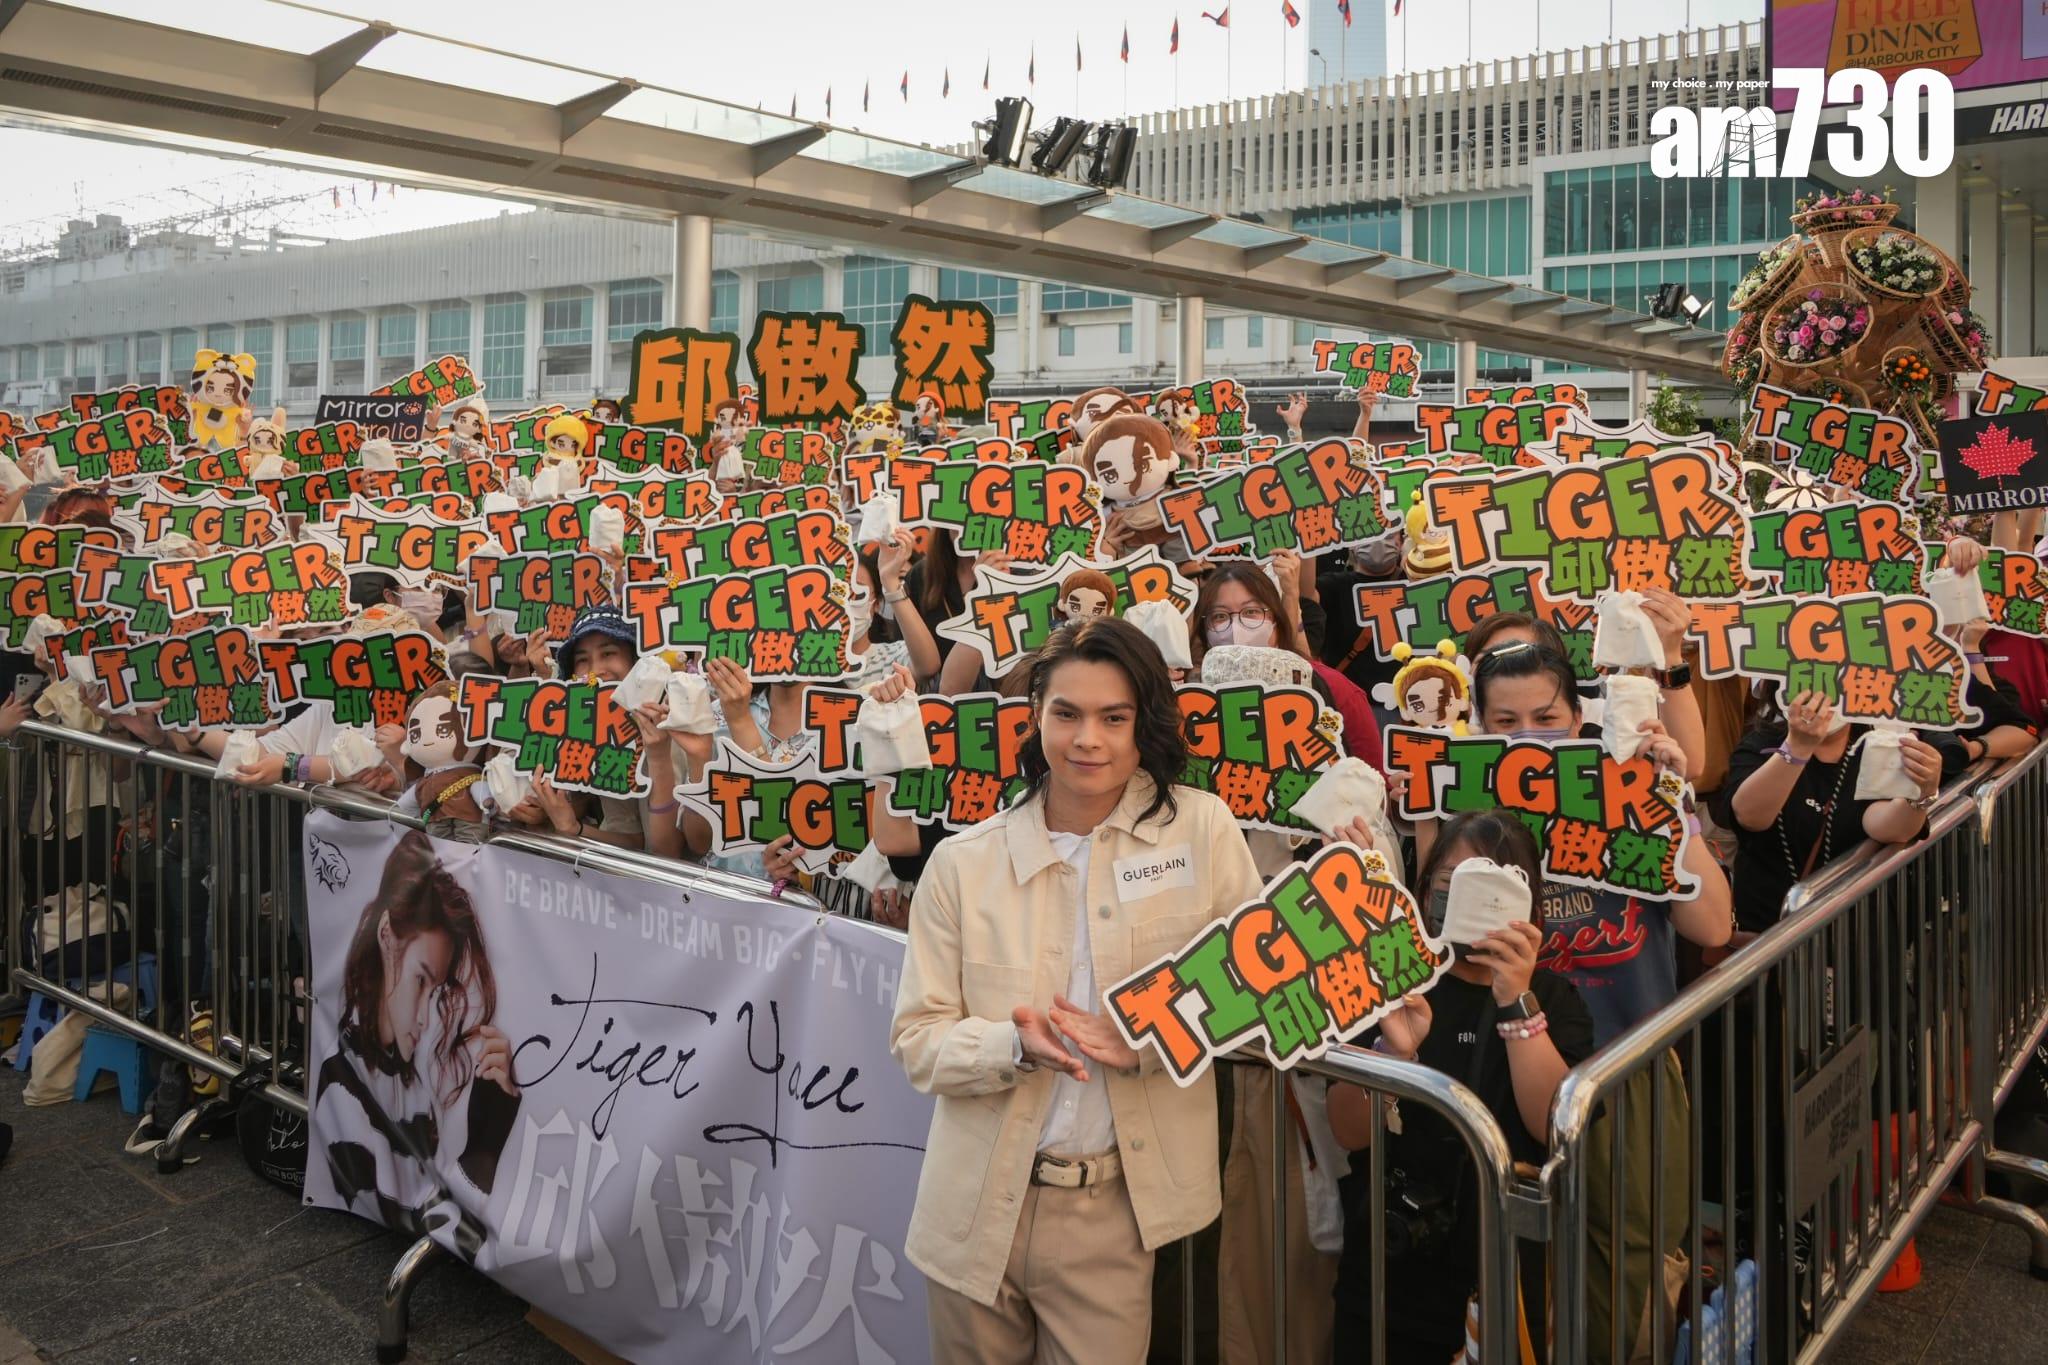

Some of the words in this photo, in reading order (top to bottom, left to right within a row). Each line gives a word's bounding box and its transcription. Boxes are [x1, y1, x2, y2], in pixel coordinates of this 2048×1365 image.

[1927, 44, 1960, 60] CITY
[628, 300, 990, 438] 邱傲然
[1313, 340, 1417, 374] TIGER
[1344, 369, 1412, 397] 邱傲然
[285, 422, 364, 461] IGER
[324, 400, 406, 419] Mirror
[988, 399, 1073, 438] TIG
[1752, 387, 1908, 468] TIGER
[77, 444, 170, 481] 邱傲然
[582, 417, 691, 473] TIGER
[742, 429, 830, 466] IGER
[754, 456, 828, 485] 邱傲然
[1797, 441, 1900, 501] 邱傲然
[889, 458, 1097, 527] TIGER
[1161, 440, 1369, 553] TIGER
[1430, 453, 1736, 570] TIGER
[141, 502, 279, 548] TIGER
[653, 512, 850, 580] TIGER
[961, 514, 1092, 565] 邱傲然
[1252, 493, 1384, 559] 邱傲然
[1749, 504, 1920, 570] IGER
[151, 543, 341, 615] TIGER
[469, 553, 611, 612] TIGER
[1550, 535, 1741, 599] 邱傲然
[1783, 556, 1916, 598] 邱傲然
[231, 586, 344, 627] 邱傲然
[625, 567, 845, 652] TIGER
[1690, 599, 1952, 676] TIGER
[91, 627, 260, 708] TIGER
[258, 633, 445, 703] TIGER
[705, 629, 842, 677] 邱傲然
[161, 683, 269, 726] 邱傲然
[461, 675, 640, 747] TIGER
[515, 732, 635, 794] 邱傲然
[1388, 729, 1678, 834] TIGER
[708, 770, 877, 852] TIGE
[1123, 858, 1186, 881] GUERLAIN
[505, 870, 532, 908] BE
[540, 877, 617, 930] BRAVE
[641, 902, 724, 961] DREAM
[733, 924, 784, 972] BIG
[811, 940, 867, 995] FLY
[1108, 847, 1396, 1079] TIGER
[1260, 918, 1436, 1058] 邱傲然
[510, 952, 717, 1140] Tiger
